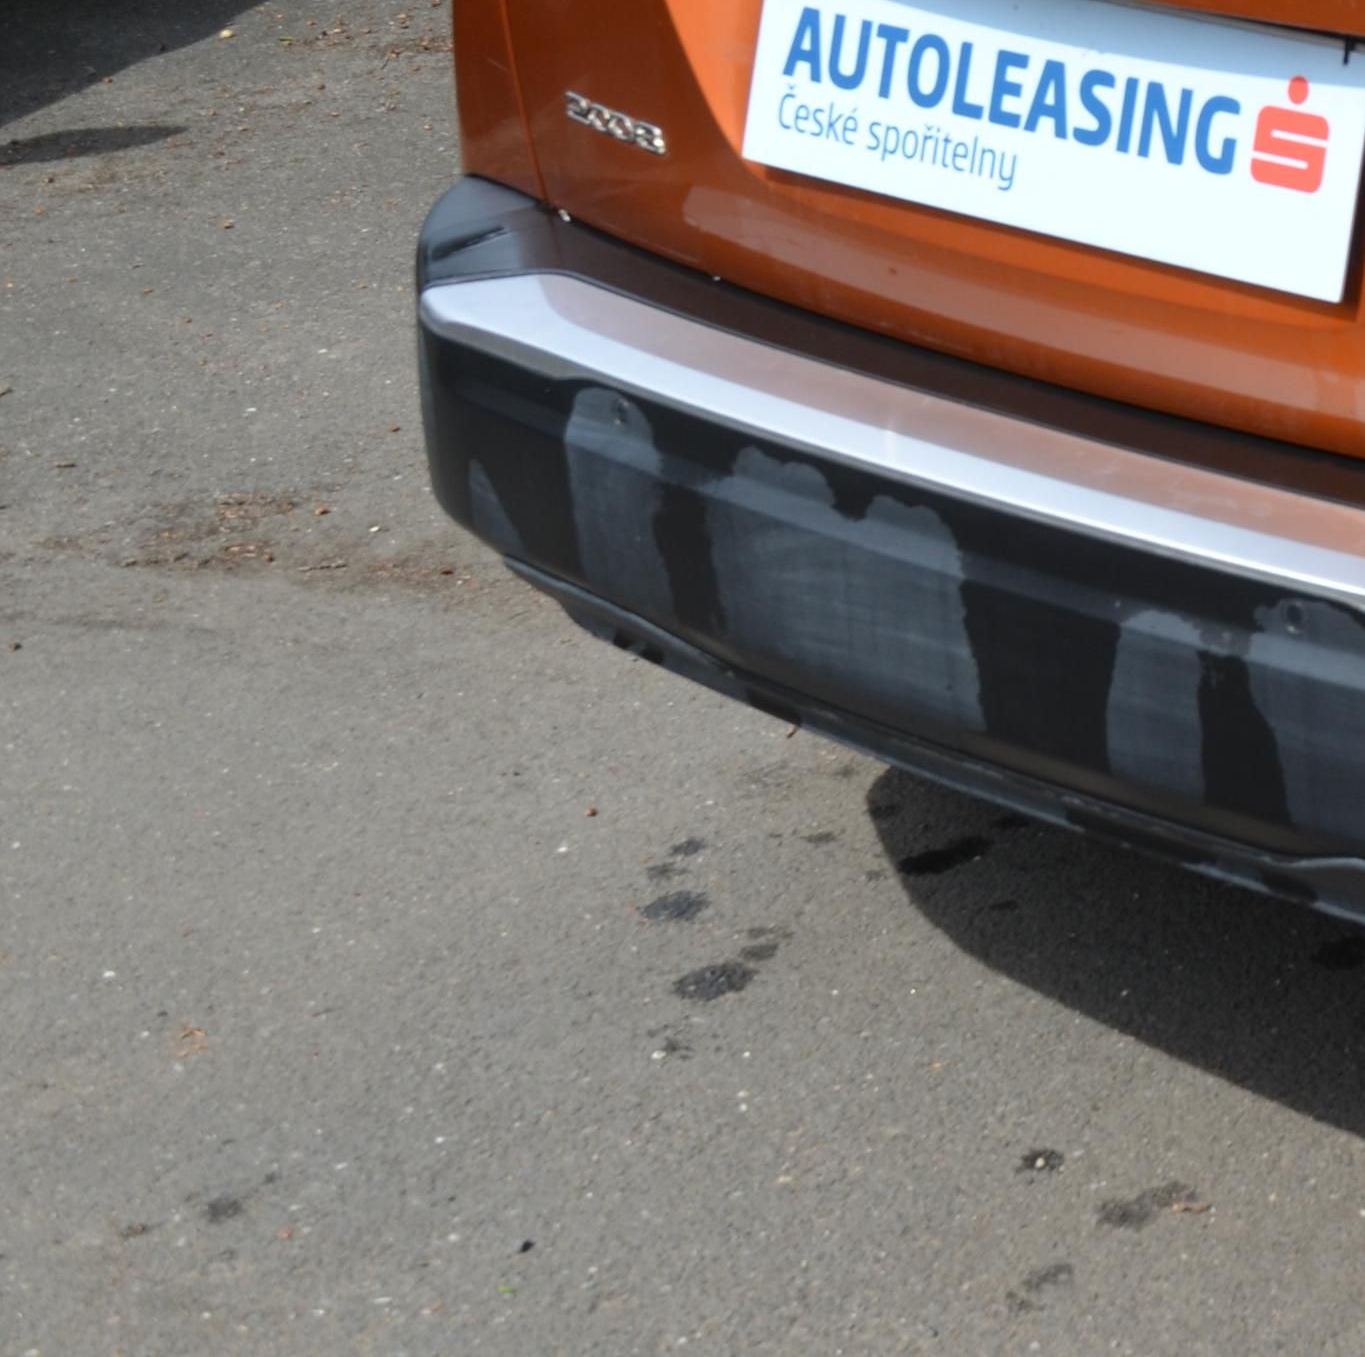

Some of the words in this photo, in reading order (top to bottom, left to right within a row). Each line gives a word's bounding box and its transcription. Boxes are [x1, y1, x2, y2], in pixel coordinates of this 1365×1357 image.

[778, 83, 859, 146] České
[866, 123, 1018, 192] spořitelny
[782, 6, 1241, 176] AUTOLEASING
